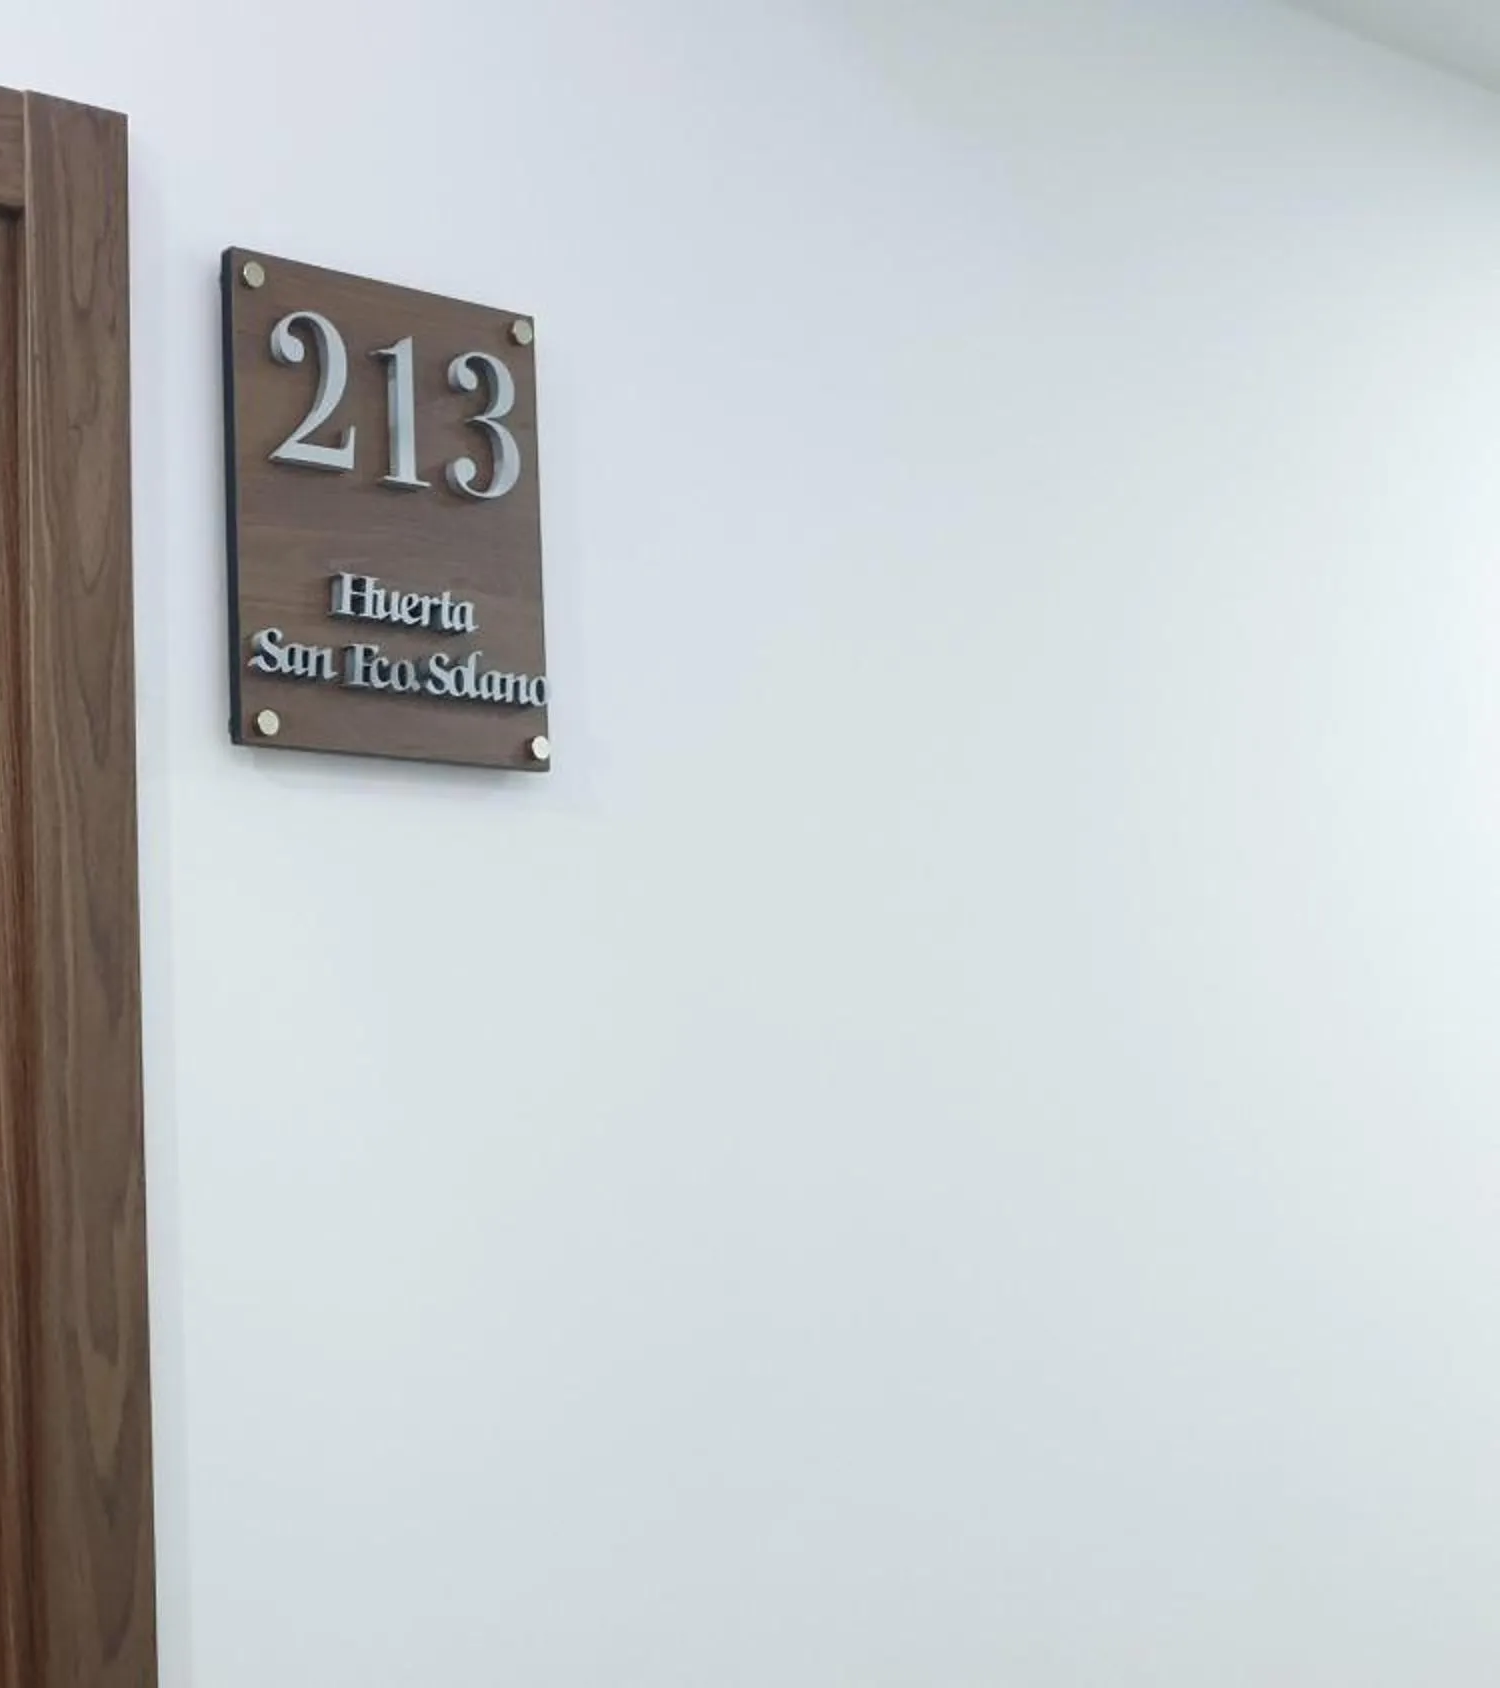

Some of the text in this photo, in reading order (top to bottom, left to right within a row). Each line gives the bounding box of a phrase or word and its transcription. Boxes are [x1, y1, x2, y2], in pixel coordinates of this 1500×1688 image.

[269, 310, 521, 499] 213
[329, 572, 479, 633] Huerta
[247, 627, 551, 707] San Fco. Solano
